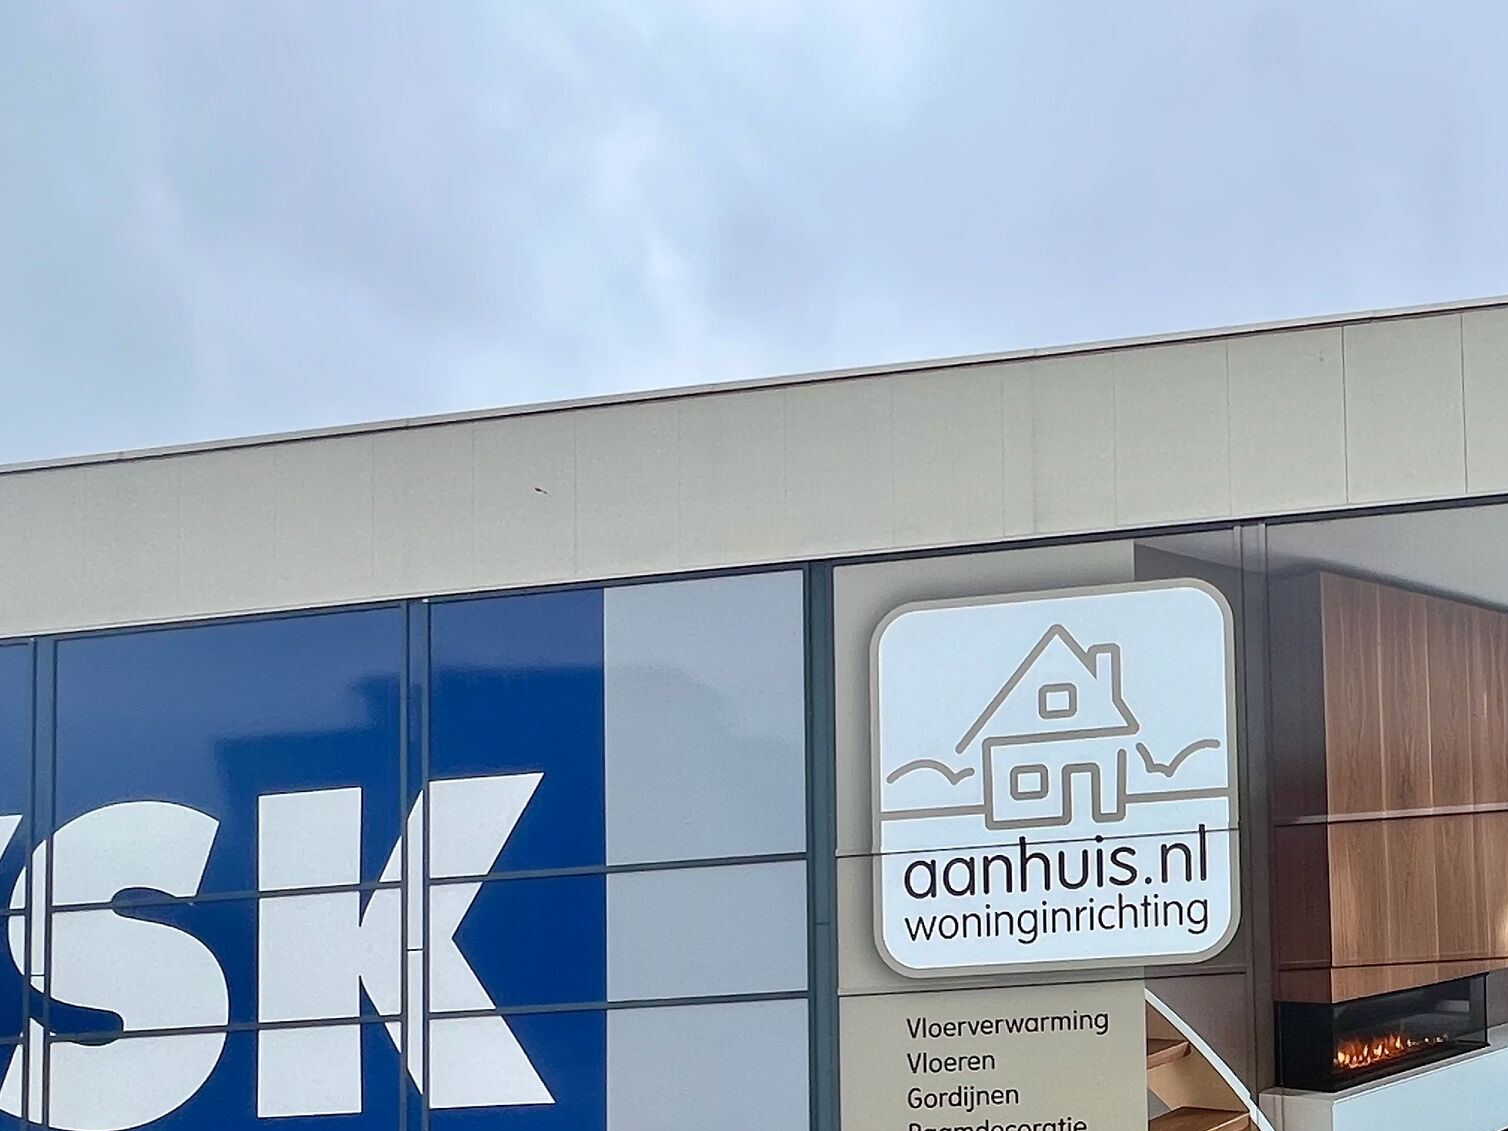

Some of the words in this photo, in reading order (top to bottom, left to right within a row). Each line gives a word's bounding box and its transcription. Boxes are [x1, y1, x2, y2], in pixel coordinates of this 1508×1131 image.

[904, 824, 1207, 899] aanhuis.nl
[904, 893, 1208, 944] woninginrichting
[906, 1010, 1109, 1039] Vloerverwarming
[906, 1052, 996, 1074] Vloeren
[907, 1086, 1019, 1113] Gordijnen
